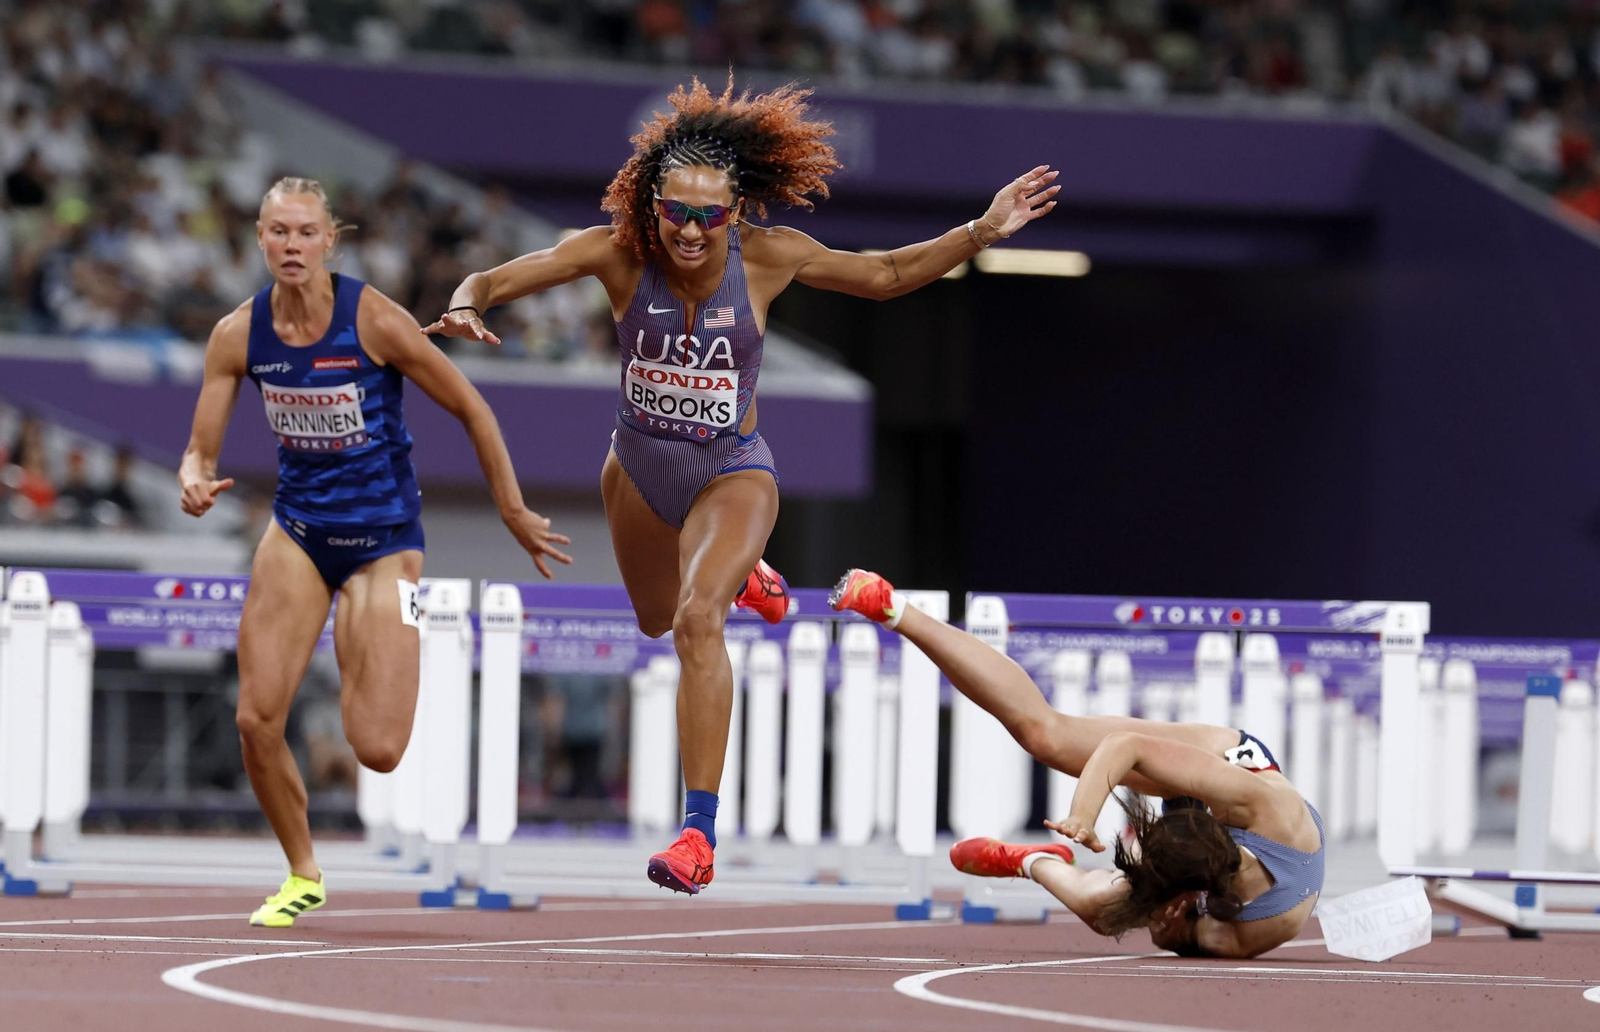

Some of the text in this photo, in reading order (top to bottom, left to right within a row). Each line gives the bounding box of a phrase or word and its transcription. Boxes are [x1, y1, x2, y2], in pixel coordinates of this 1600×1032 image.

[636, 329, 735, 370] USA
[251, 363, 283, 375] CRAFT
[314, 359, 358, 370] motonet
[629, 364, 736, 391] HONDA
[264, 389, 356, 406] HONDA
[631, 382, 731, 425] BROOKS
[269, 410, 358, 434] VANNINEN
[327, 536, 366, 547] CRAFT
